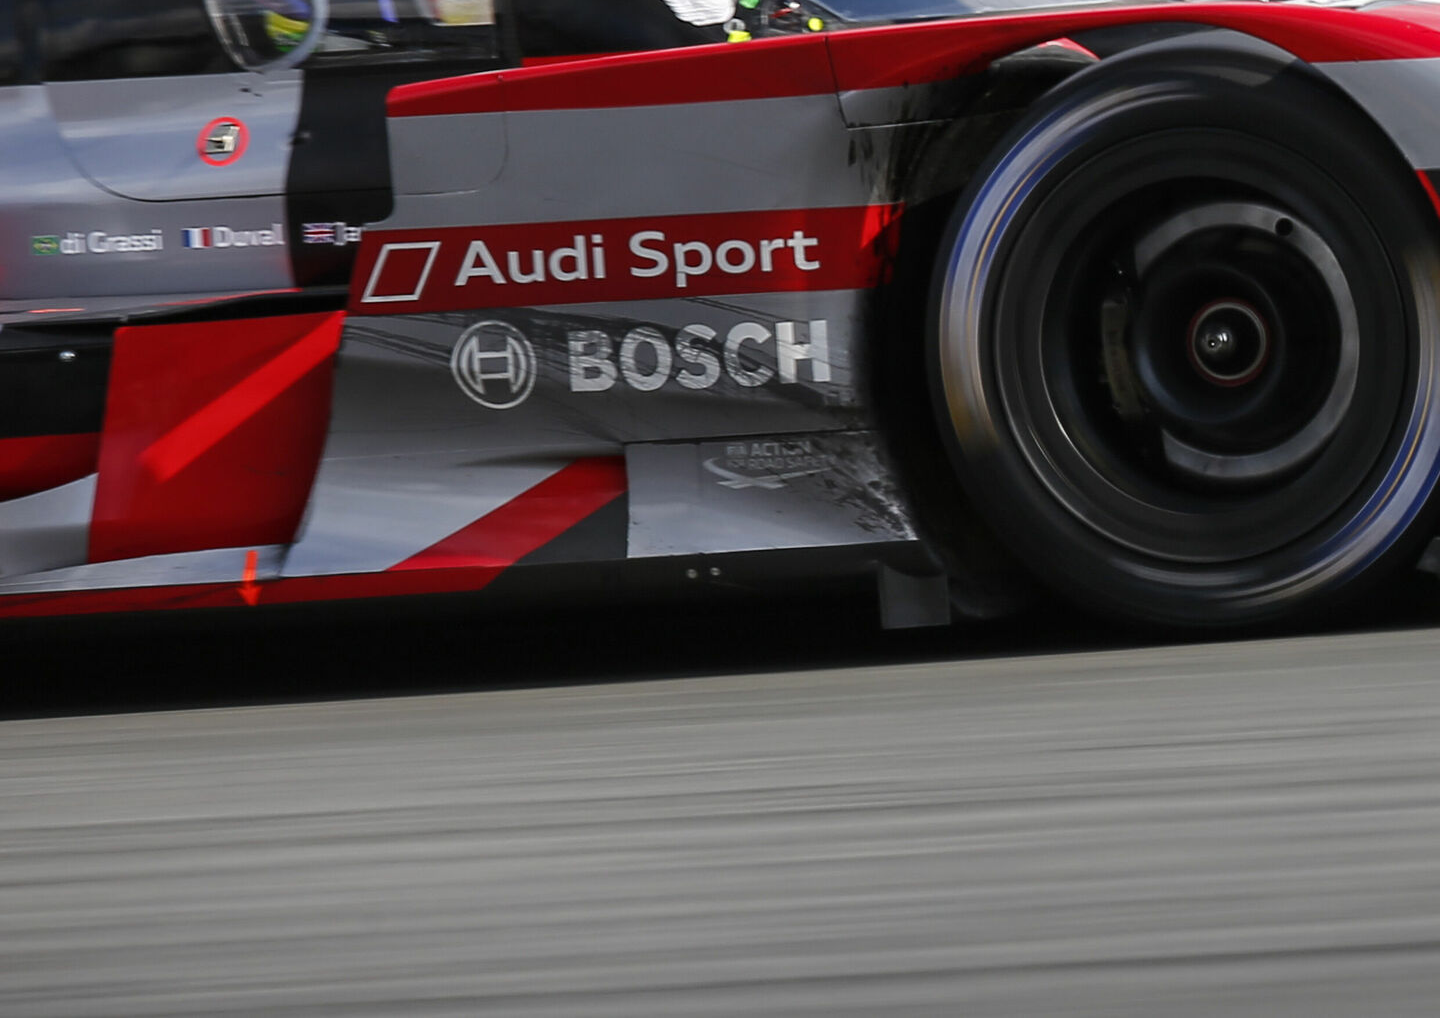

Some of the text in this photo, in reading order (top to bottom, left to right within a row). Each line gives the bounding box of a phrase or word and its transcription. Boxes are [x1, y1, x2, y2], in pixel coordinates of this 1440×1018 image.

[59, 229, 164, 256] di Grassi
[212, 223, 286, 249] Duval
[454, 230, 821, 288] Audi Sport
[568, 319, 832, 393] BOSCH
[751, 440, 812, 457] ACTION
